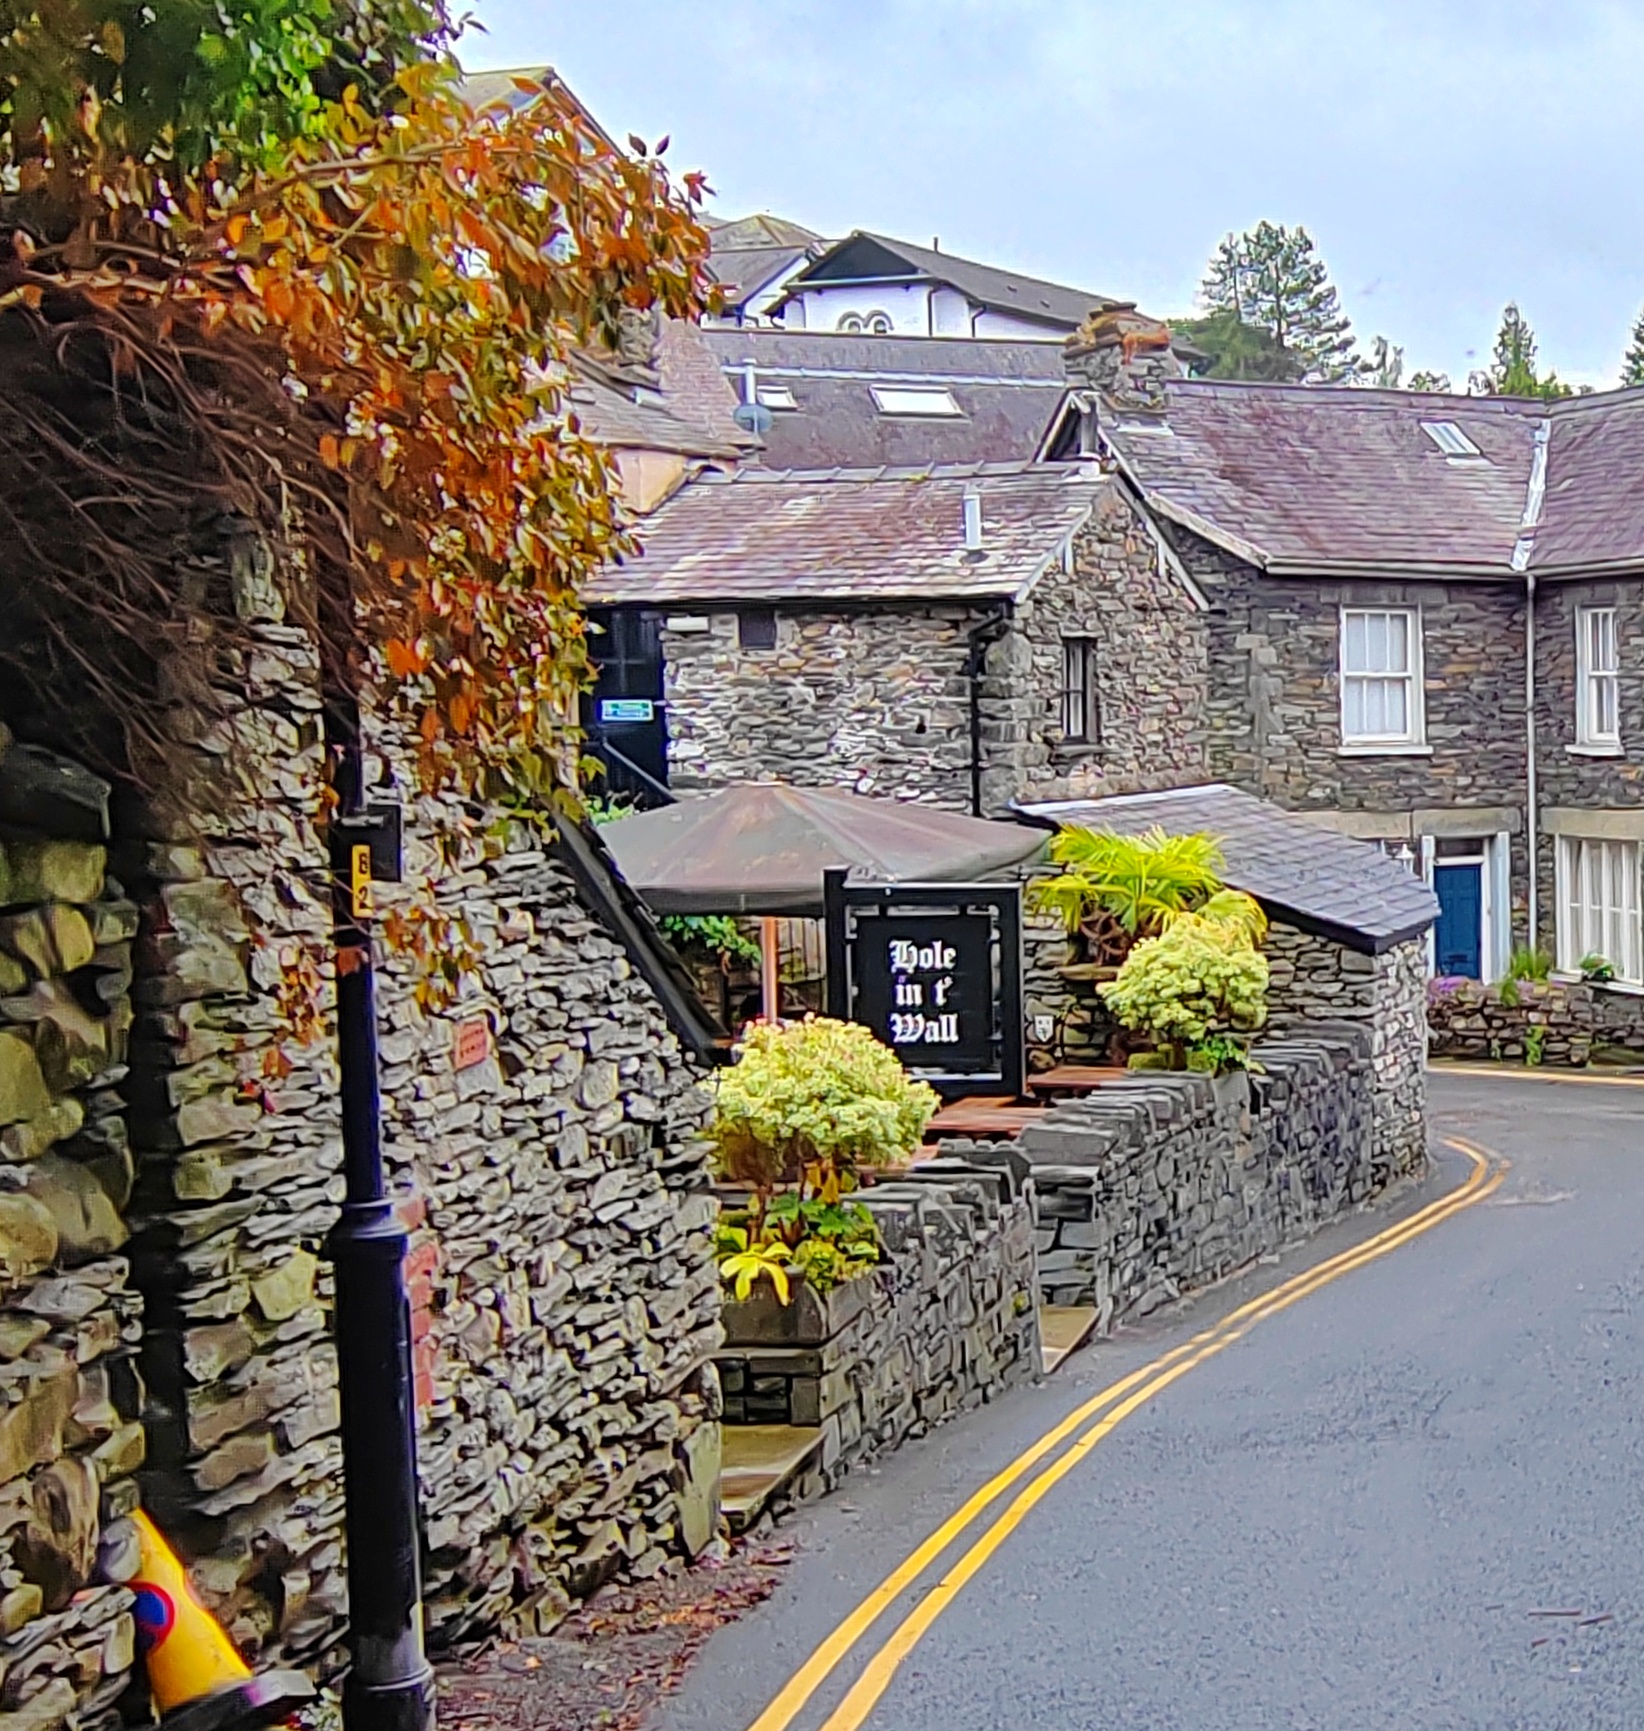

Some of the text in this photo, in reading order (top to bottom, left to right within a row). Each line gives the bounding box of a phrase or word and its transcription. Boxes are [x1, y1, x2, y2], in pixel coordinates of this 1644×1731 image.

[889, 939, 956, 974] Hole
[895, 975, 922, 1006] in
[890, 1012, 959, 1043] Wall
